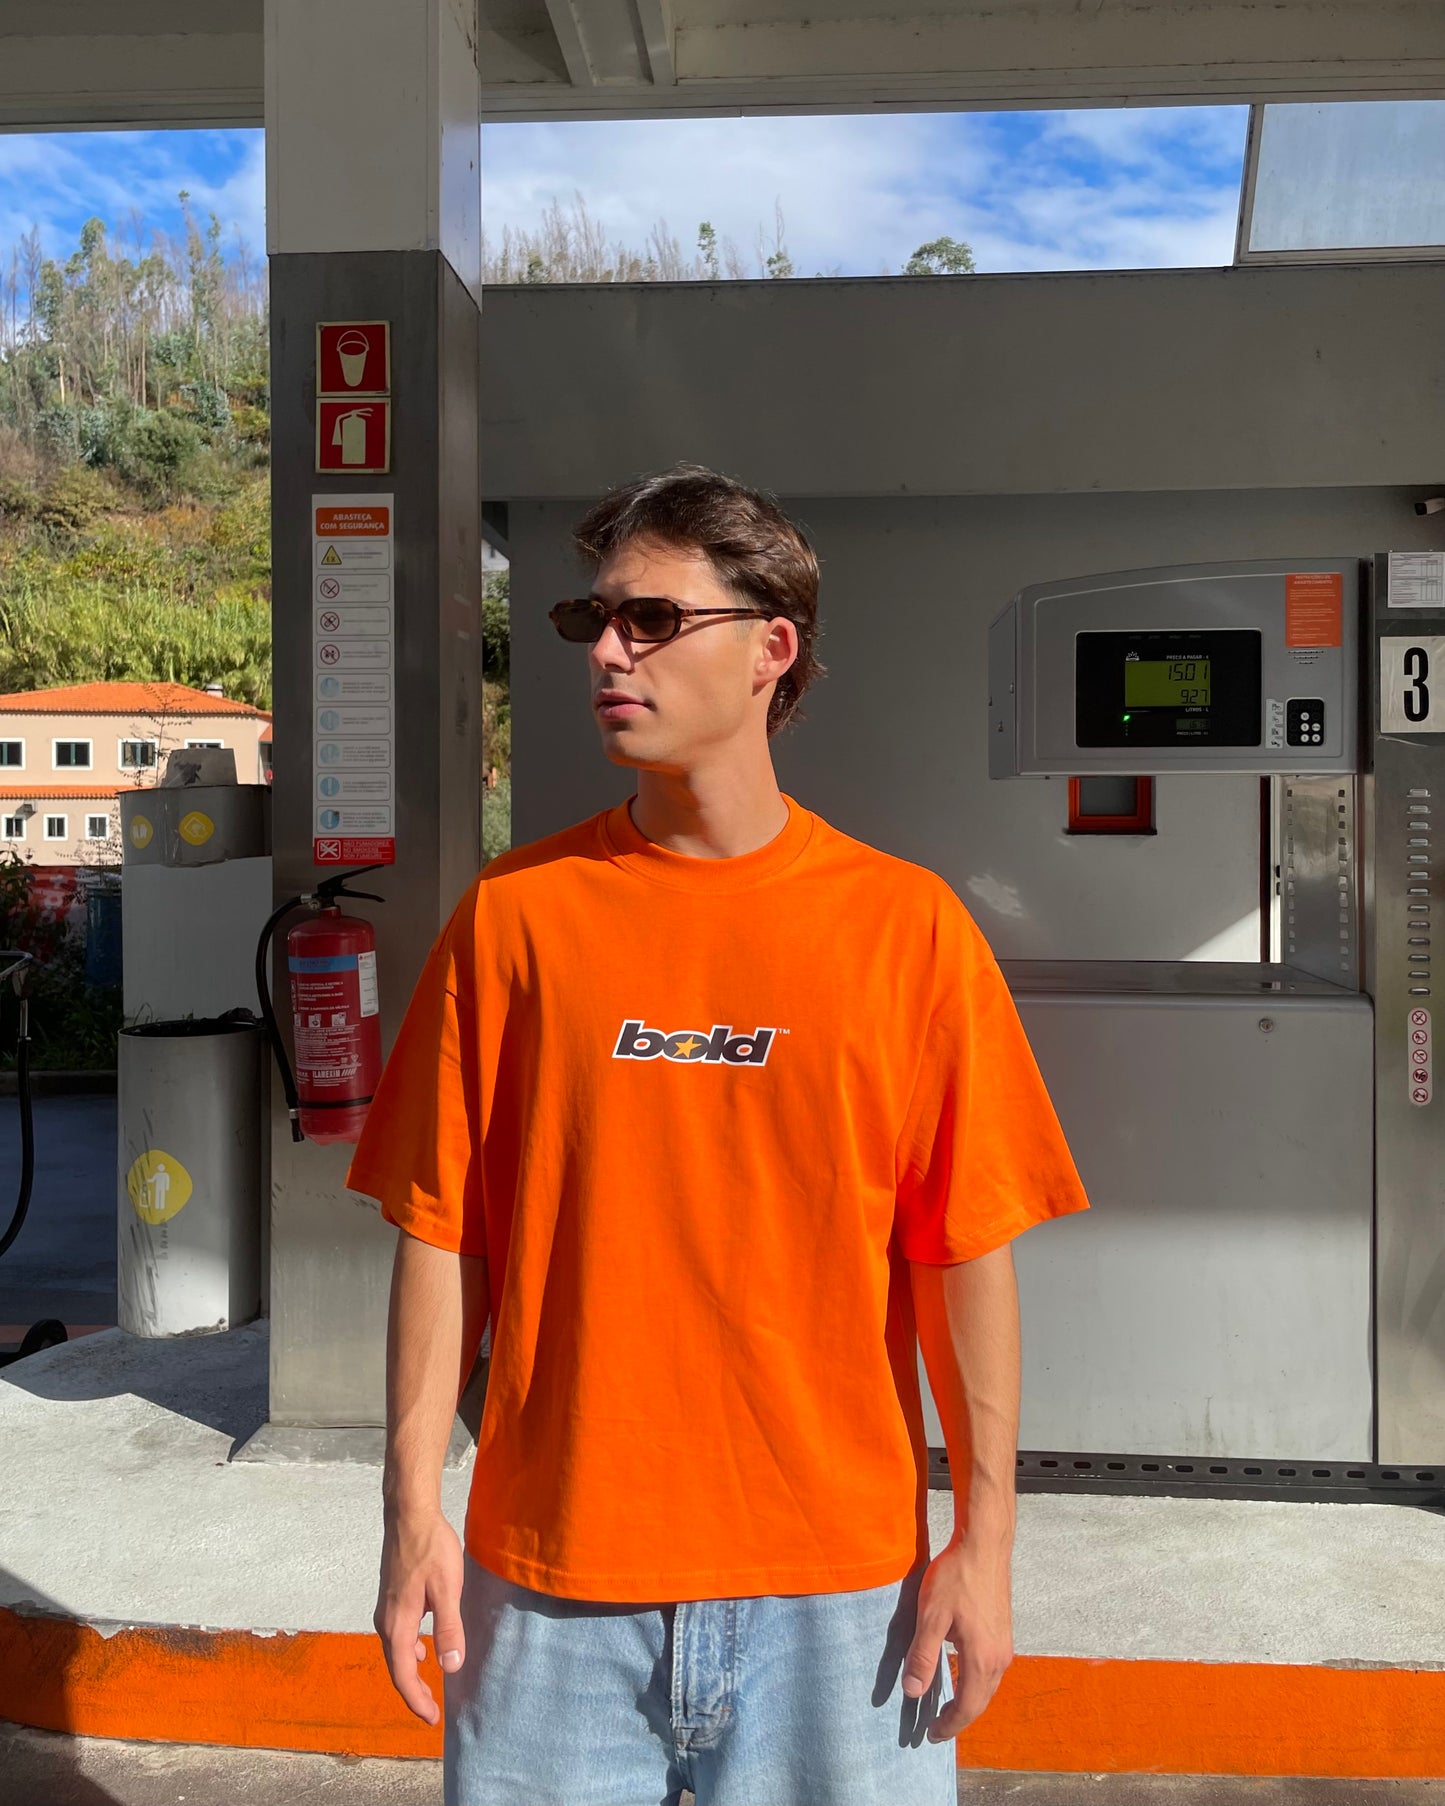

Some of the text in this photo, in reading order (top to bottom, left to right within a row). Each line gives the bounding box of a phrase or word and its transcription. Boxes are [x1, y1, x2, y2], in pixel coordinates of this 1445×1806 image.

[320, 522, 385, 531] COM SEGURANÇA
[332, 513, 372, 522] ABASTEÇA
[1403, 647, 1430, 722] 3
[612, 1020, 777, 1066] bold
